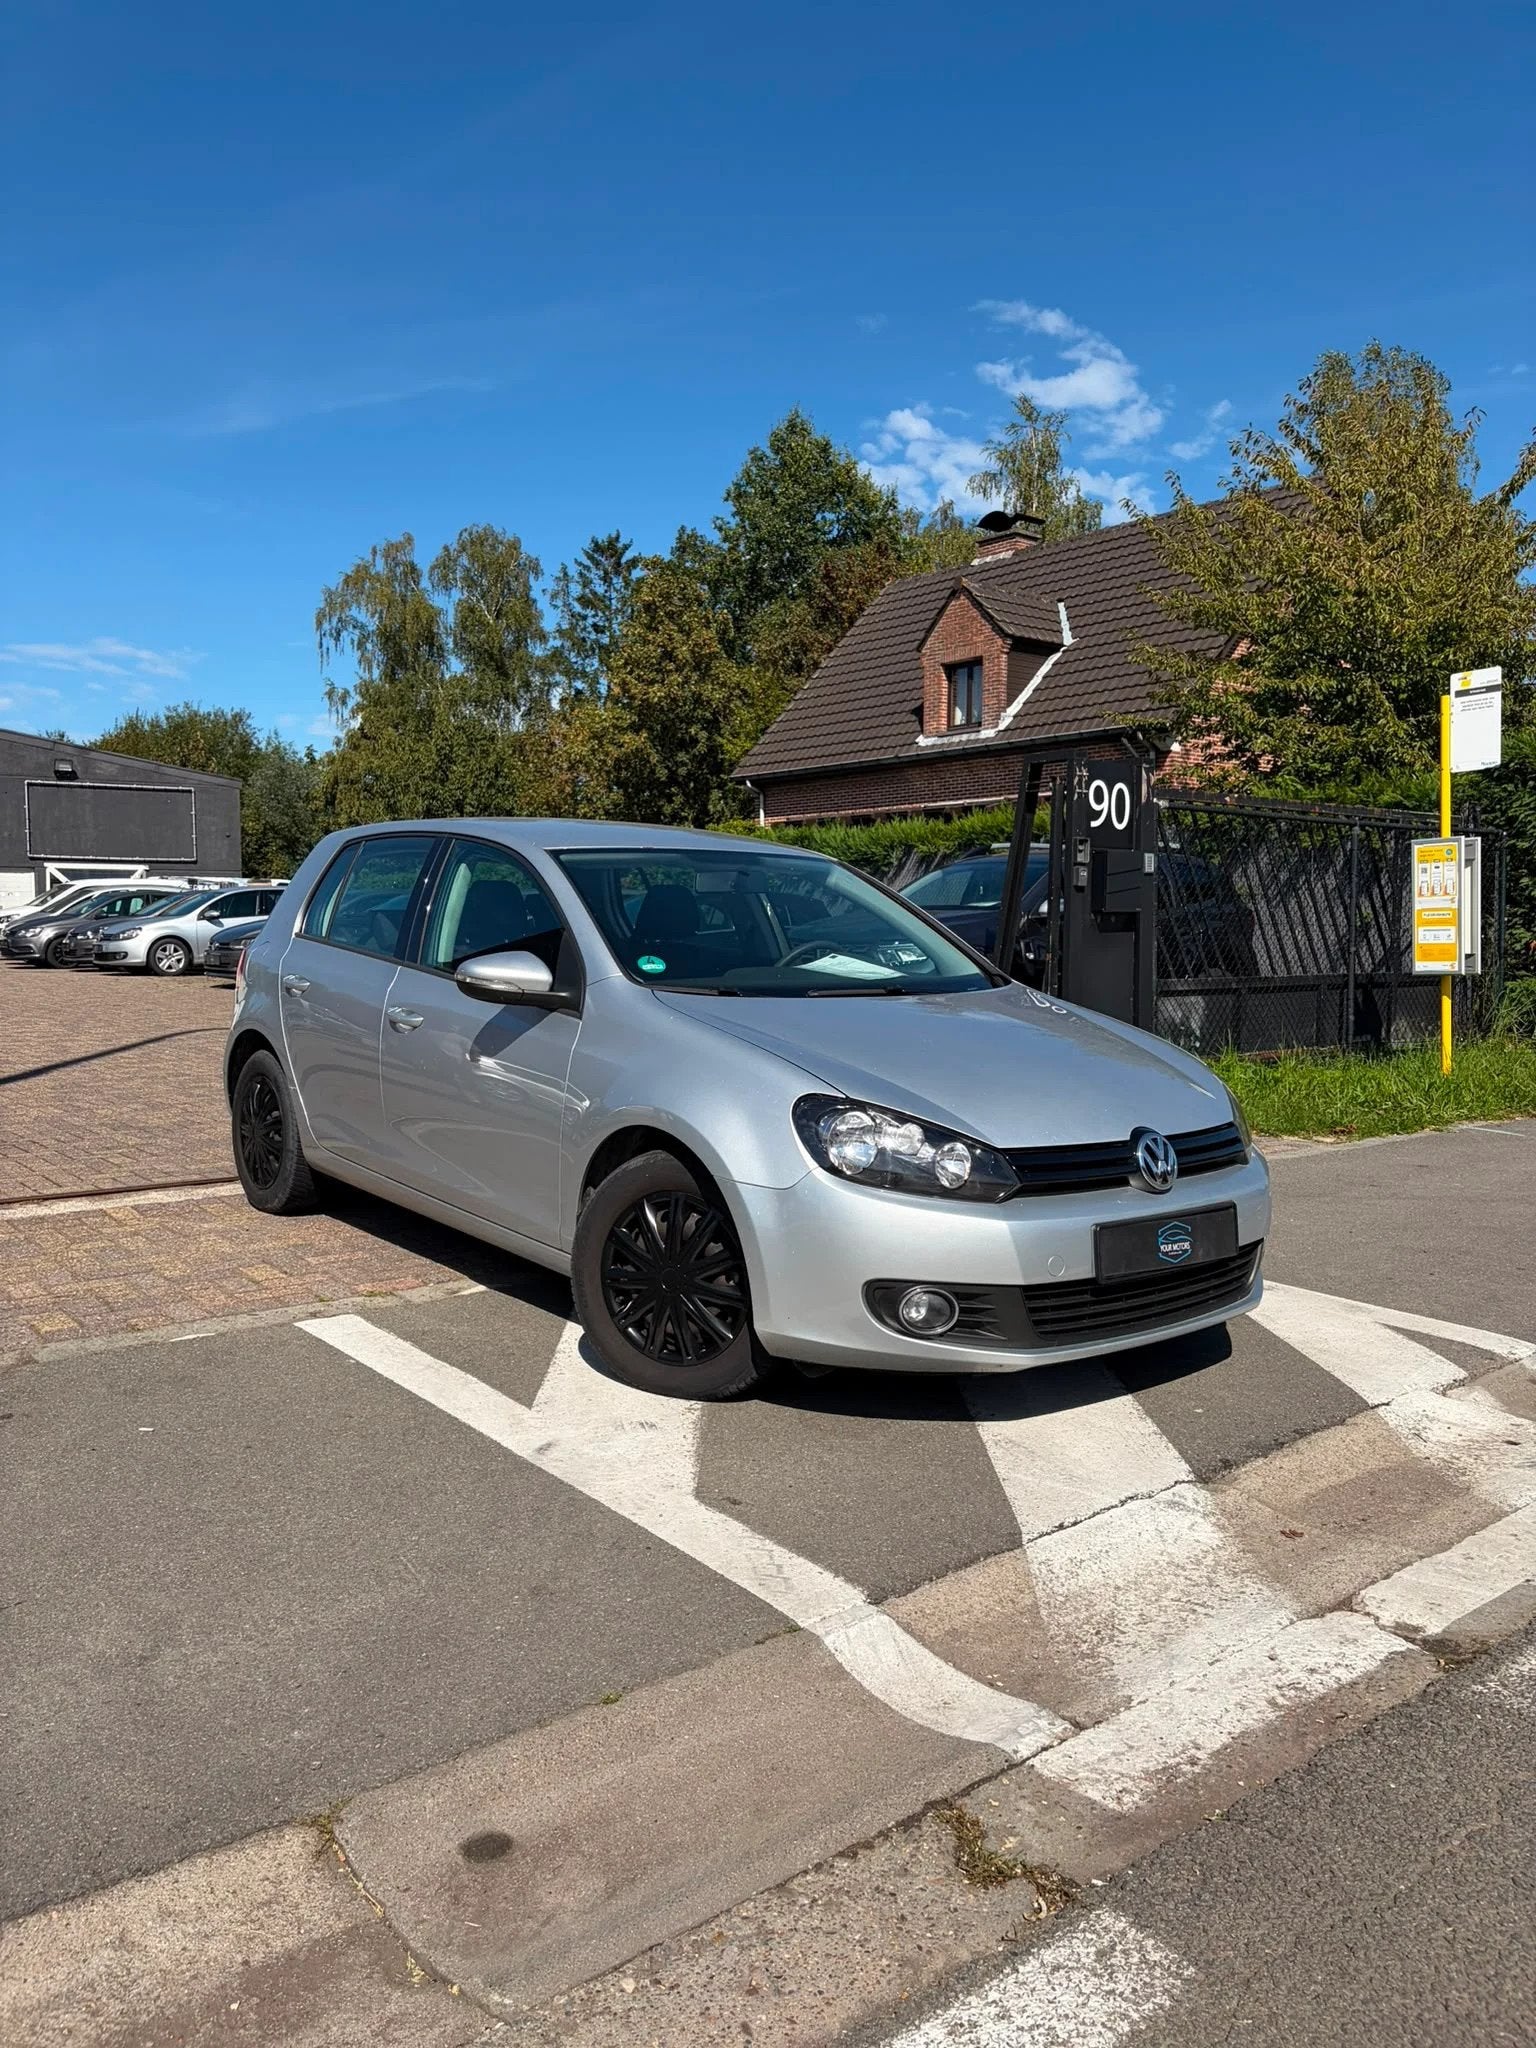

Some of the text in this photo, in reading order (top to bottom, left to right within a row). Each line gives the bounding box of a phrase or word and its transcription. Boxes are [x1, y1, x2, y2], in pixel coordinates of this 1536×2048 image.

[1089, 779, 1130, 830] 90
[1160, 1241, 1190, 1252] YOUR MOTORS
